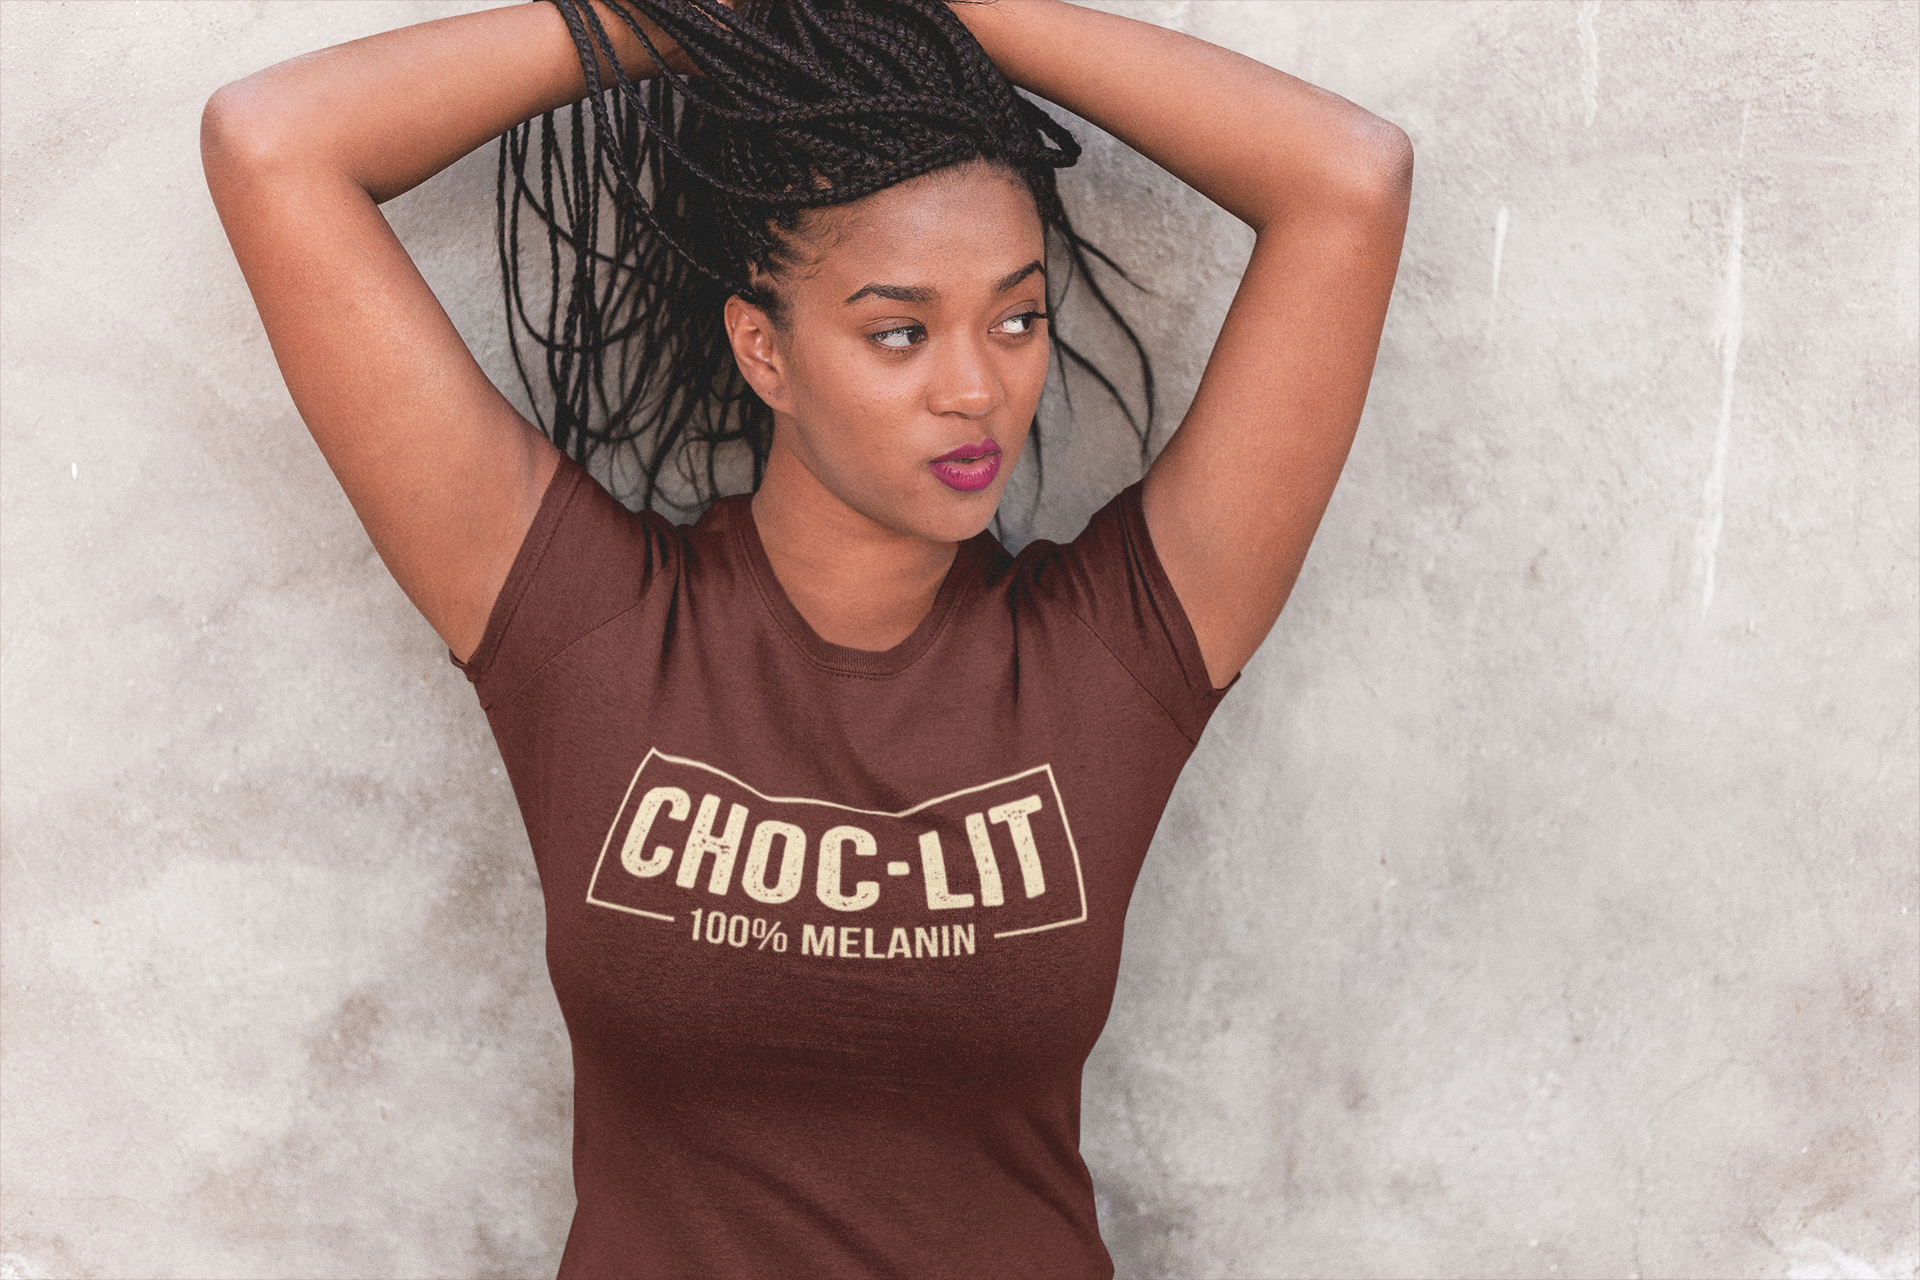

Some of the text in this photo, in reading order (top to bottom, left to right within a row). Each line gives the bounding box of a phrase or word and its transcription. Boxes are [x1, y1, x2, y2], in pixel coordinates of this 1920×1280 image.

[620, 786, 1046, 912] CHOC-LIT
[690, 907, 976, 959] 100% MELANIN
